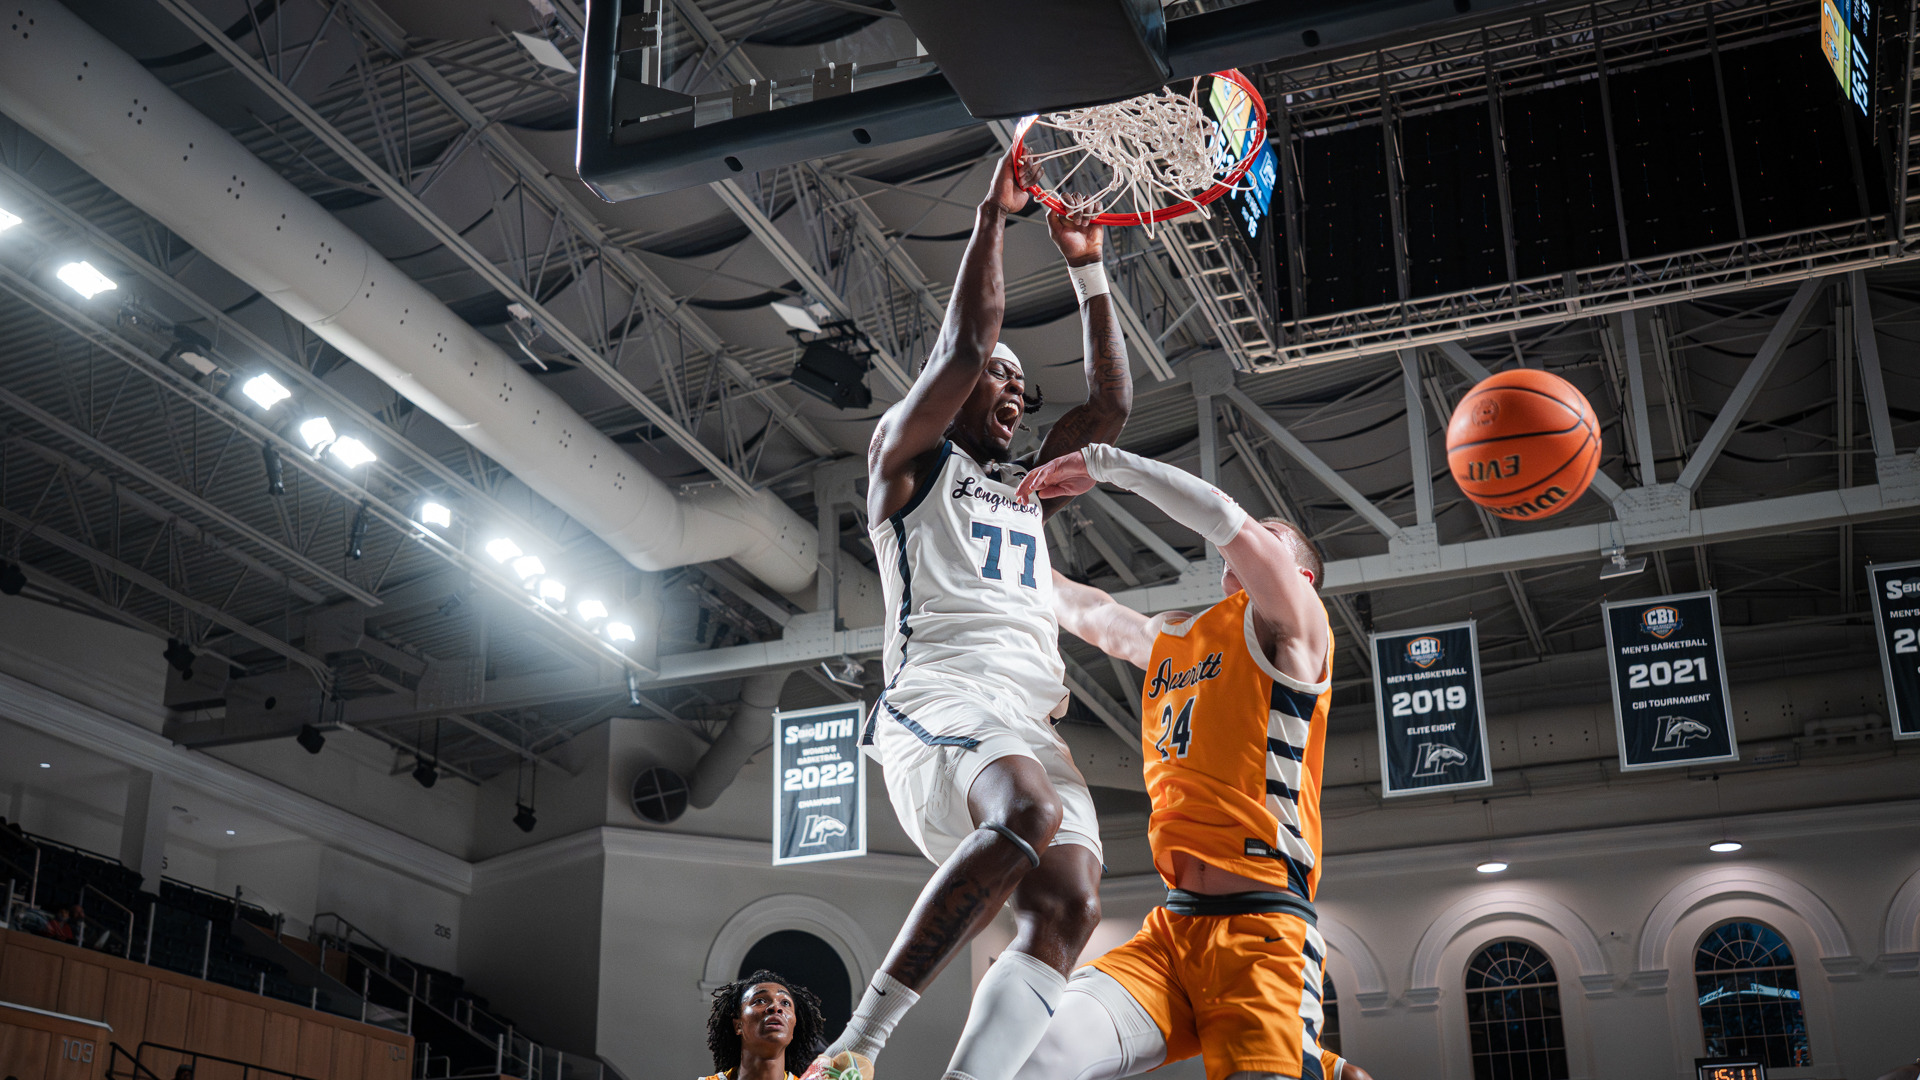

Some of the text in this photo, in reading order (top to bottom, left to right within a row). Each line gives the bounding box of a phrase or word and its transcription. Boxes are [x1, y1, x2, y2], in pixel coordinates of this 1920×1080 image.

[1852, 34, 1869, 117] 15:11
[970, 519, 1038, 590] 77
[1647, 608, 1675, 626] CBI
[1411, 639, 1438, 655] CBI
[1621, 638, 1708, 655] MEN'S BASKETBALL
[1893, 628, 1920, 654] 2
[1386, 667, 1468, 685] MEN'S BASKETBALL
[1628, 657, 1707, 689] 2021
[1392, 685, 1467, 718] 2019
[1632, 693, 1711, 710] CBI TOURNAMENT
[1155, 695, 1198, 763] 24
[1406, 722, 1456, 736] ELITE EIGHT
[797, 753, 842, 765] BASKETBALL
[784, 761, 854, 791] 2022
[434, 923, 452, 940] 206
[63, 1039, 95, 1064] 103
